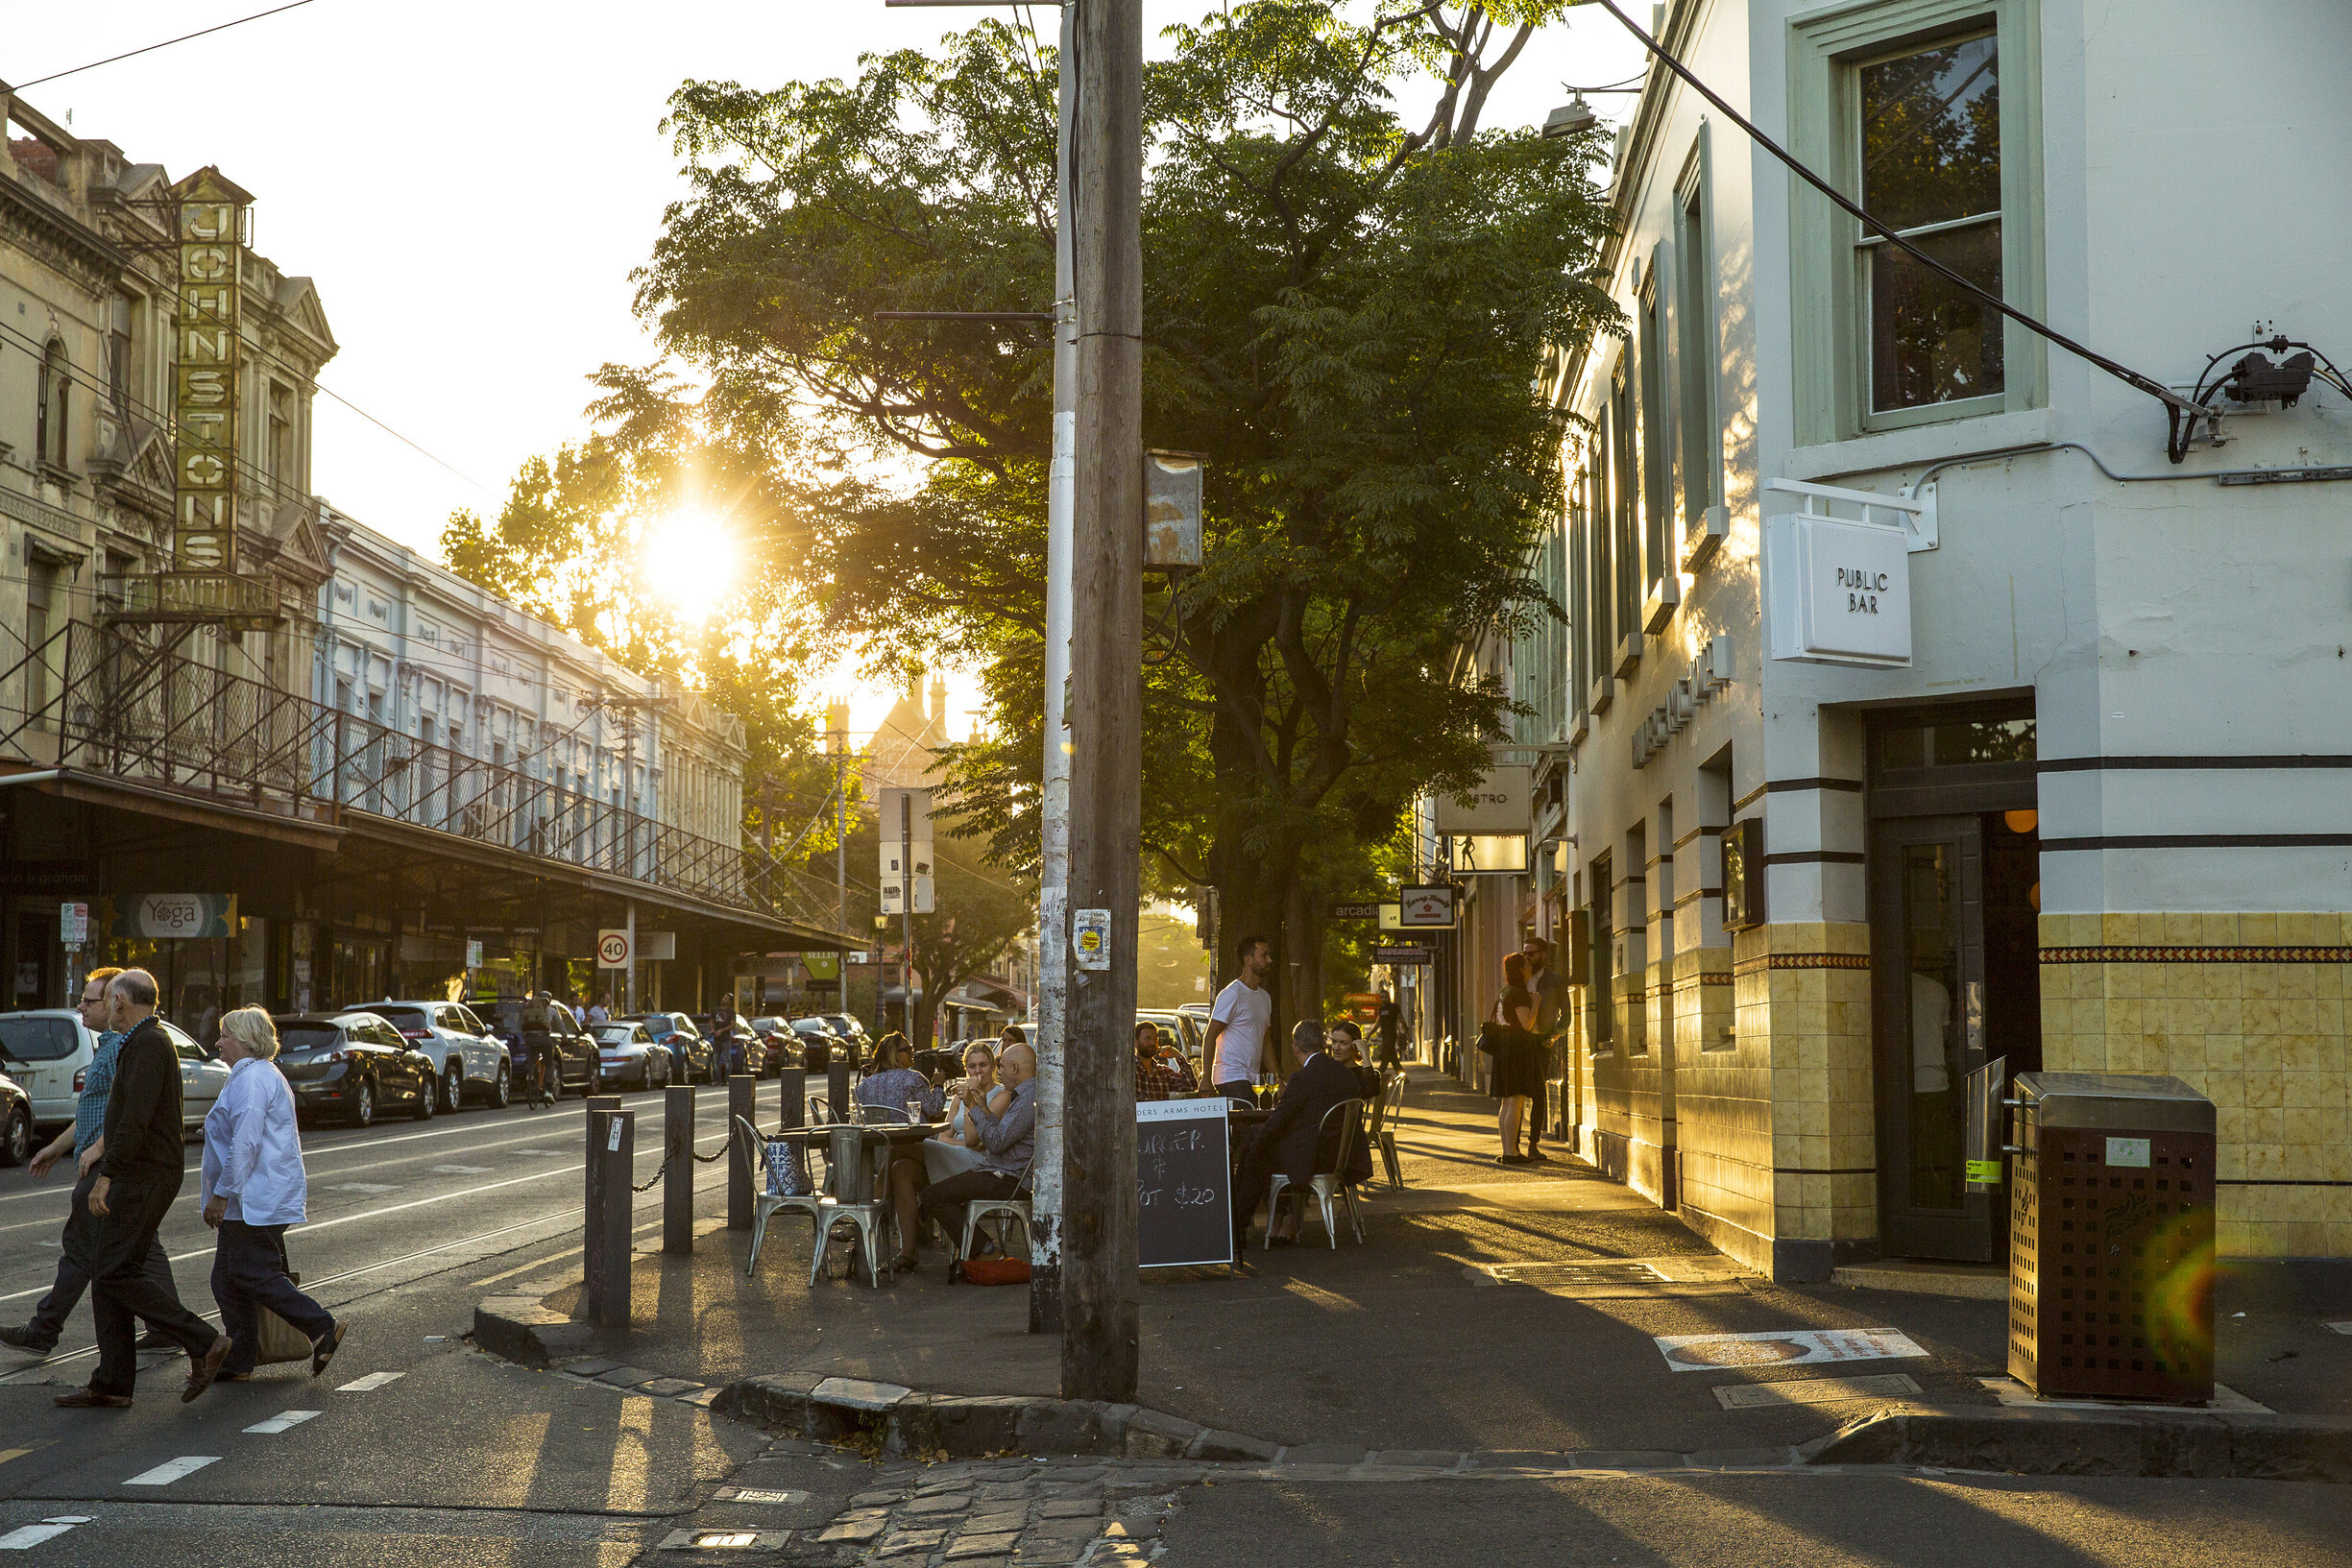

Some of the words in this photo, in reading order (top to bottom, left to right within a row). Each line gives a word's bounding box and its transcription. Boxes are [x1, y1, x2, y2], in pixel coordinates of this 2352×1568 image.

[183, 205, 228, 571] JOHNSTONS
[1835, 567, 1888, 592] PUBLIC
[1848, 592, 1879, 615] BAR
[1465, 793, 1508, 804] STRO
[146, 901, 196, 929] Yoga
[603, 943, 623, 955] 40
